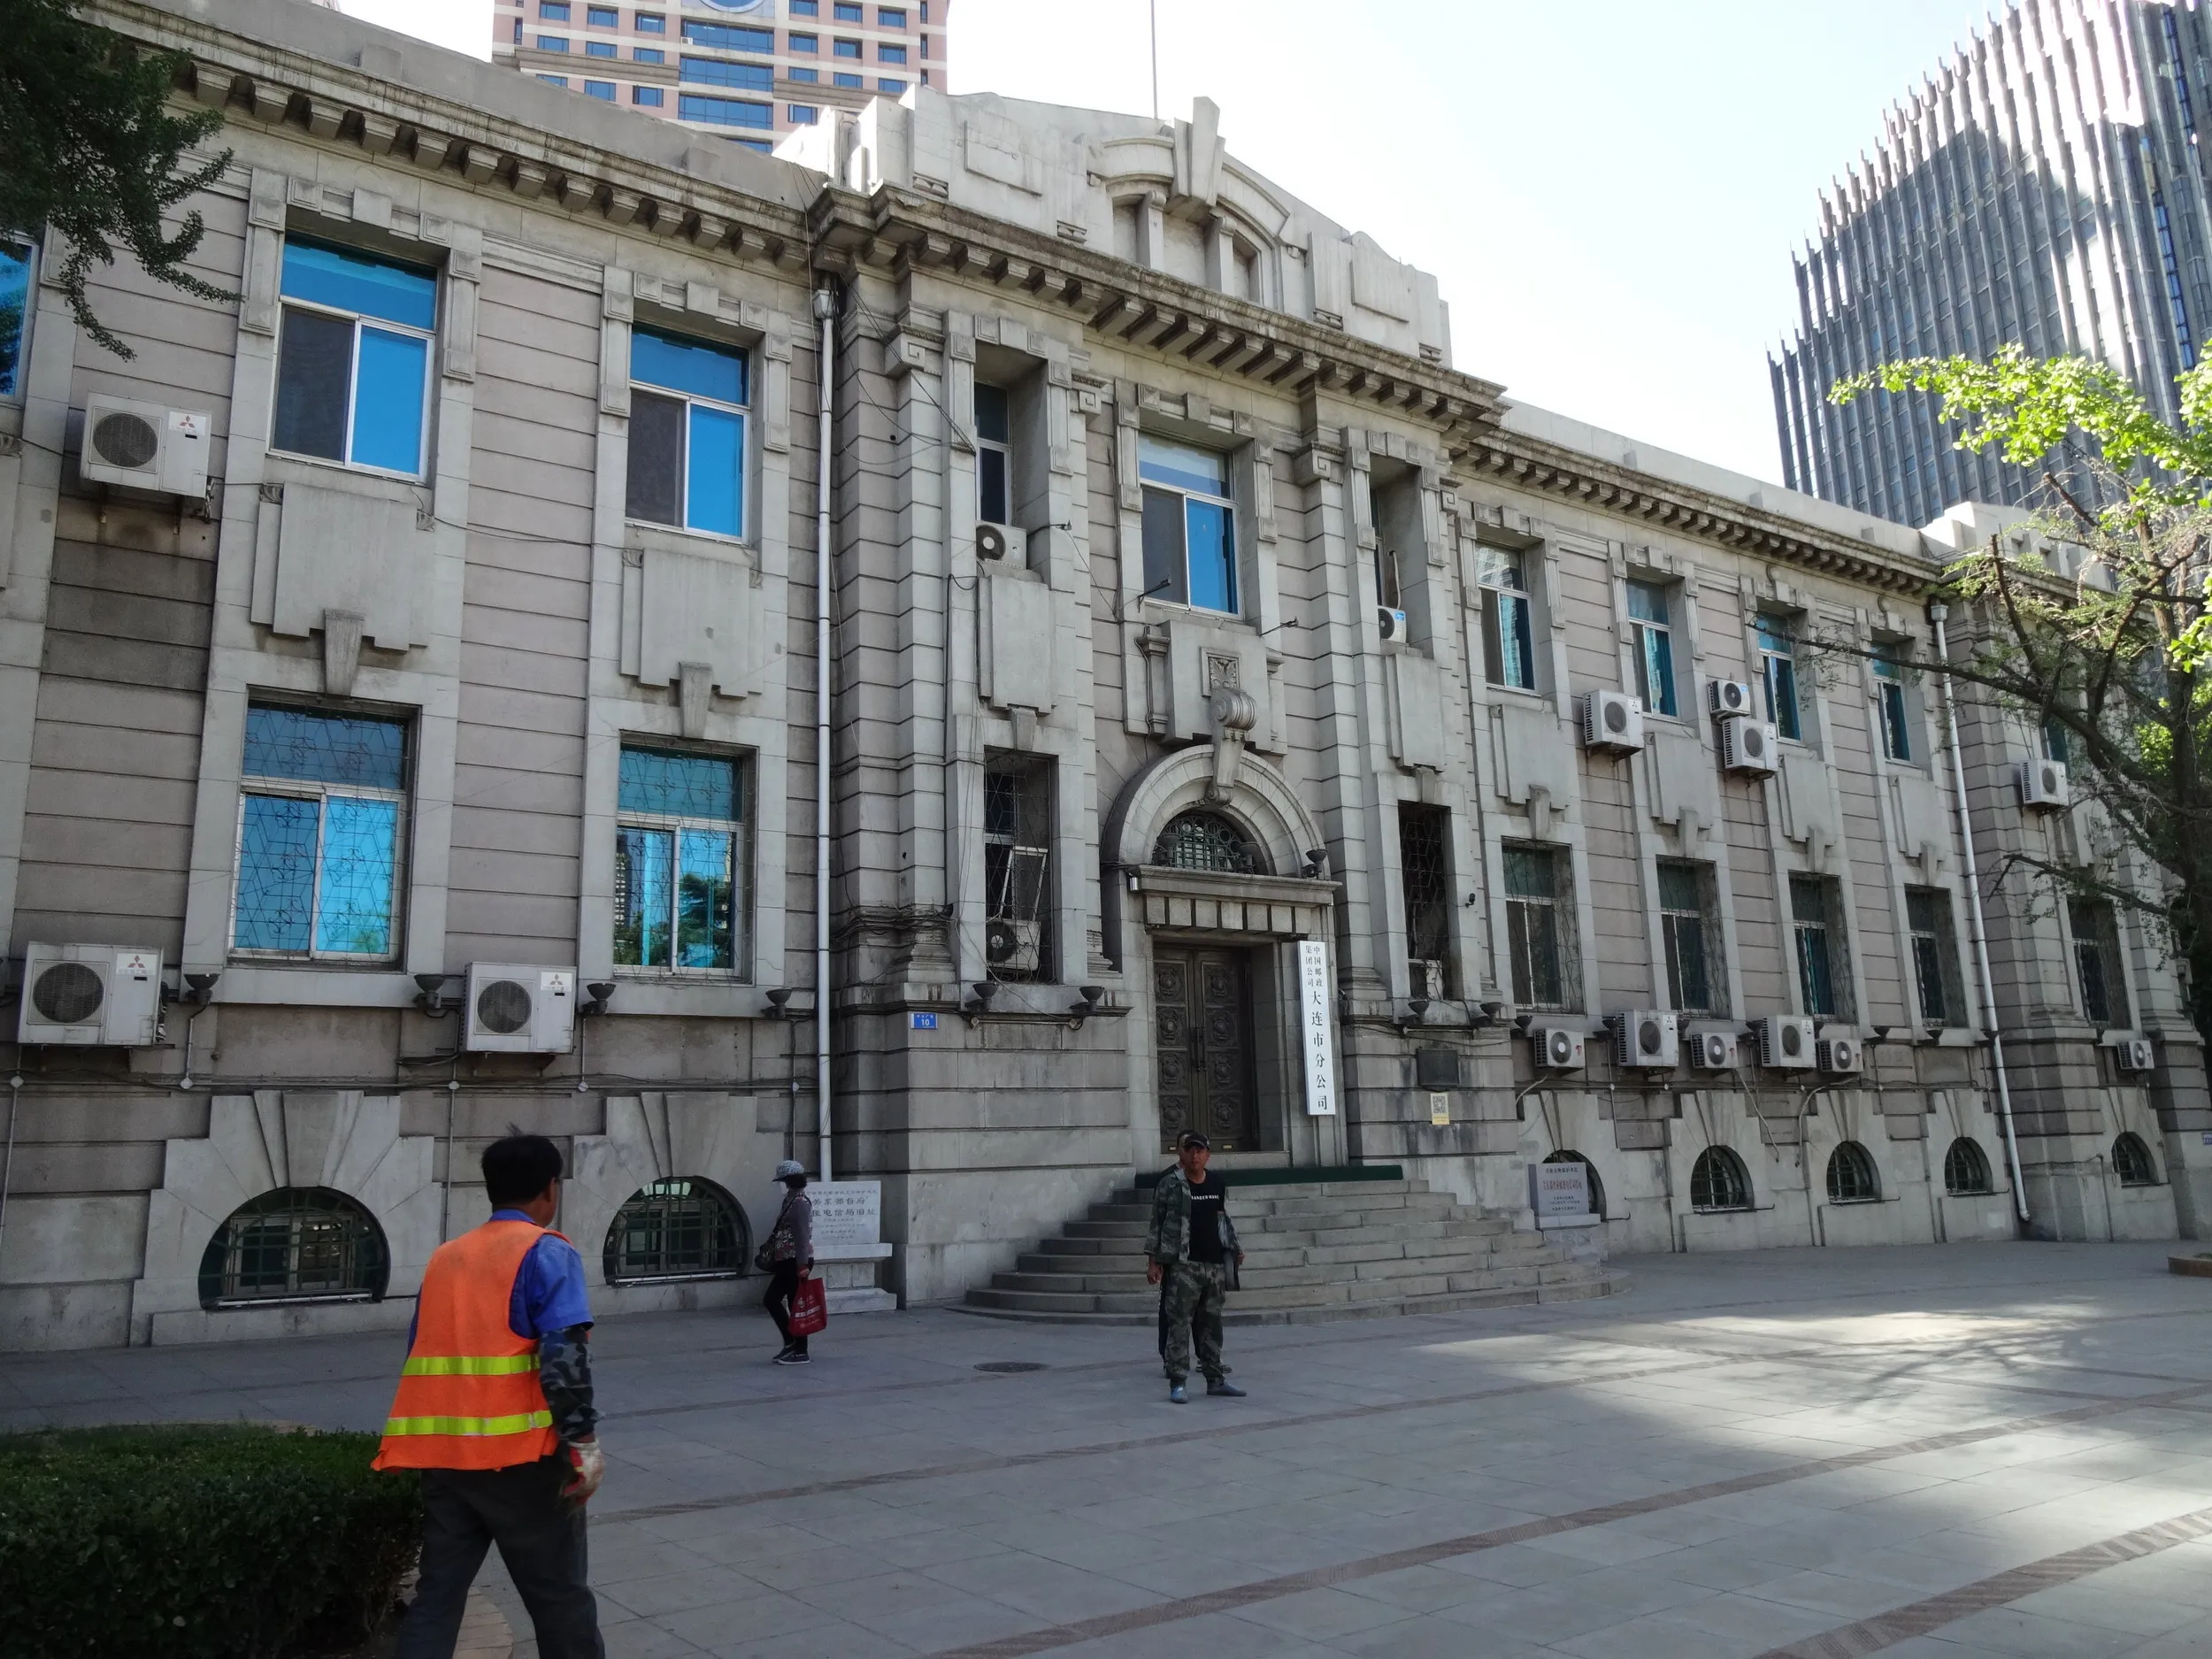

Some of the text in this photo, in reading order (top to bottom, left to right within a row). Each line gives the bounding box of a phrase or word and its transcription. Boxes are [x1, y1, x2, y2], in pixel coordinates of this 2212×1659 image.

[1305, 945, 1314, 987] 集团公司
[1313, 945, 1323, 987] 中国邮政
[1311, 991, 1327, 1110] 大连市分公司
